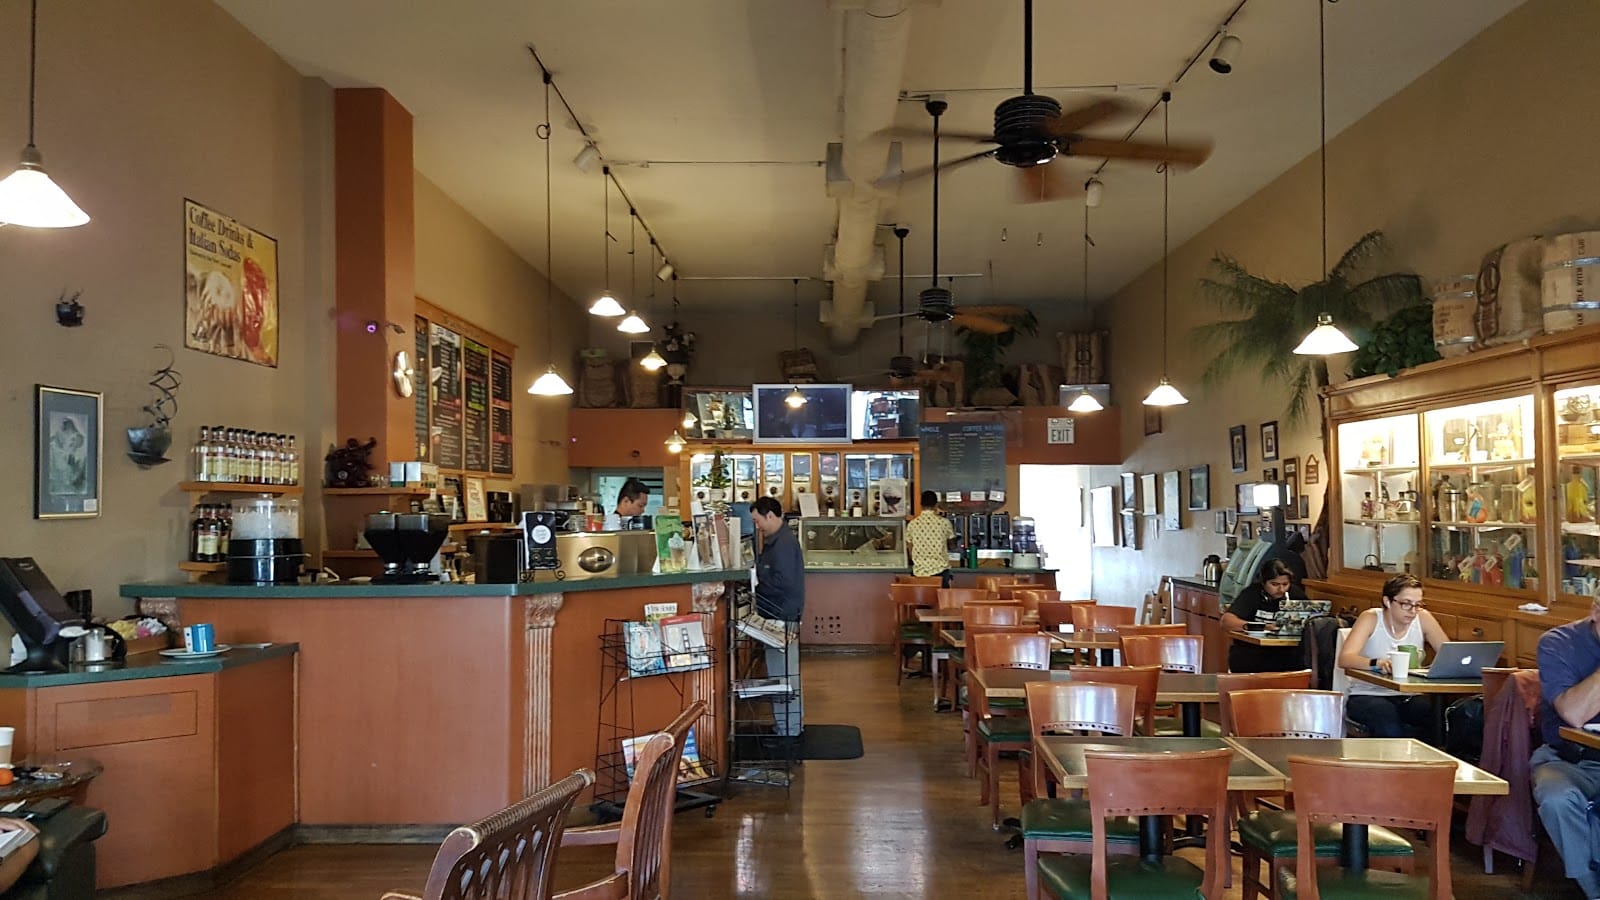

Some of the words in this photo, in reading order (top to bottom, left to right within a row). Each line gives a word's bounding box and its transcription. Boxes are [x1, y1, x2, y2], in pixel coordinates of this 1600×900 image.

[189, 227, 217, 254] Italian
[219, 240, 241, 263] Sodas
[190, 206, 216, 233] Coffee
[218, 218, 244, 246] Drinks
[247, 232, 254, 249] &
[1051, 429, 1071, 442] EXIT
